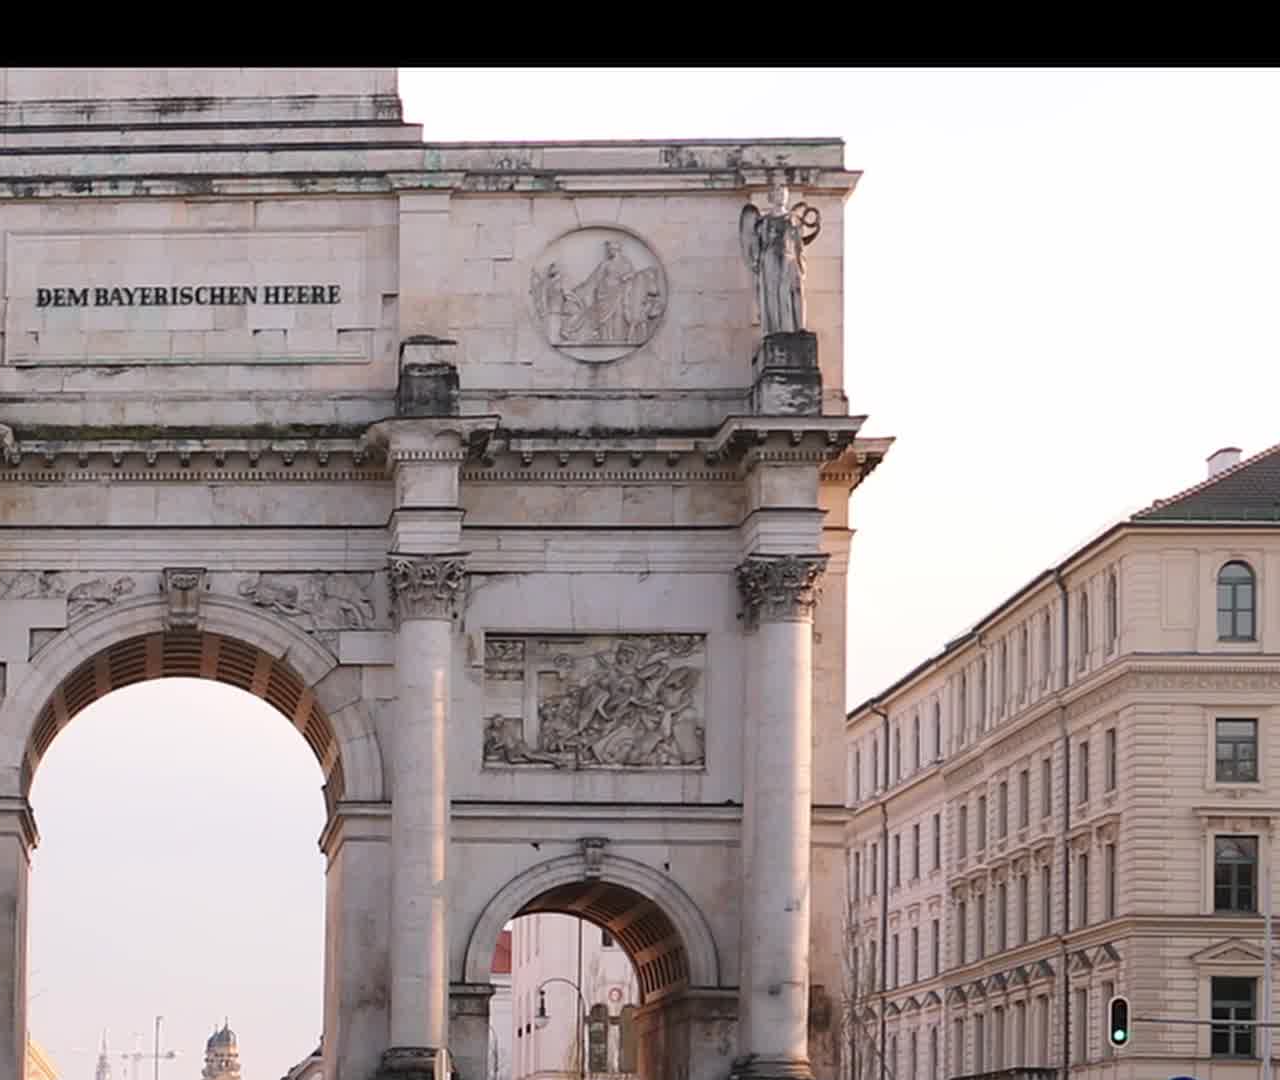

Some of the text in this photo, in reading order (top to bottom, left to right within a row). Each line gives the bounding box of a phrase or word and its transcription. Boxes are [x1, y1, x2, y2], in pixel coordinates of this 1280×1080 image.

[35, 285, 340, 308] DEM BAYERISCHEN HEERE
